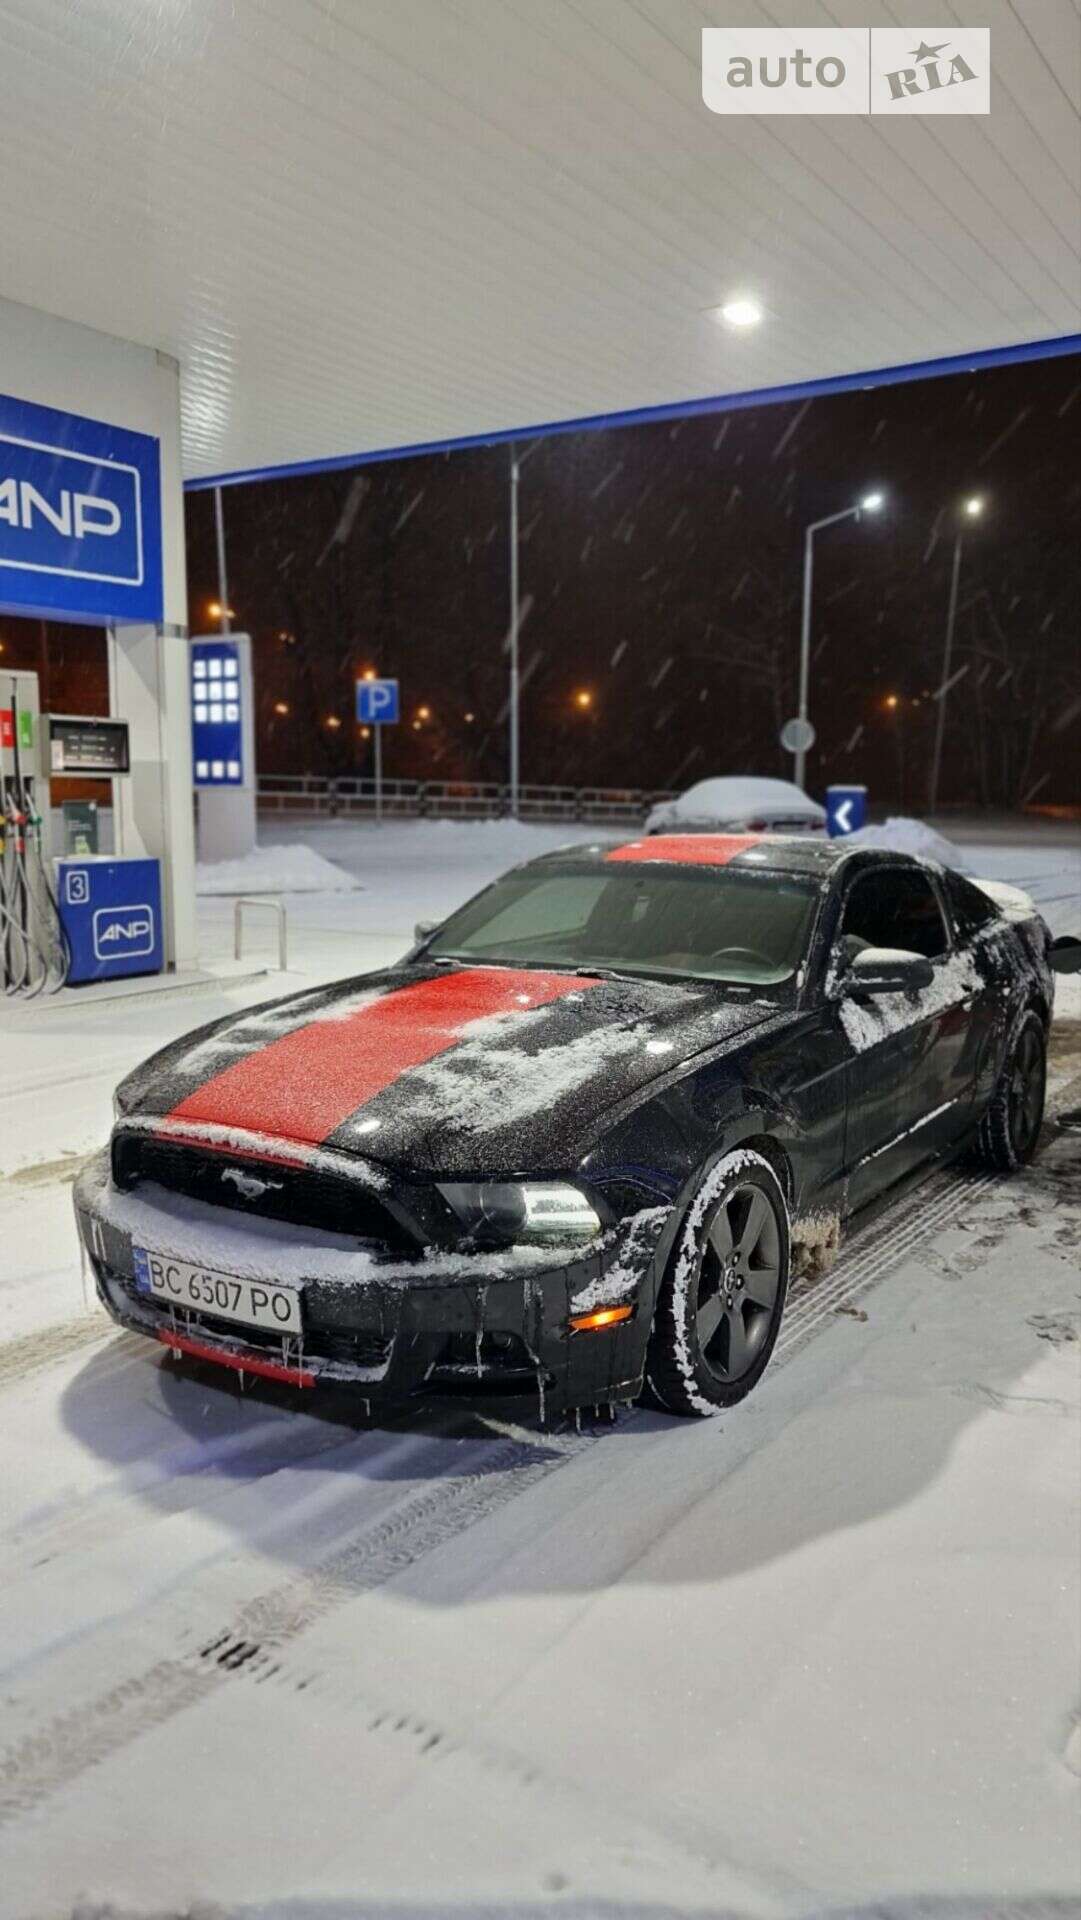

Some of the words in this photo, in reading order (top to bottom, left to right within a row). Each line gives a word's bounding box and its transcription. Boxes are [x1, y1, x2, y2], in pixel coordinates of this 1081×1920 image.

[369, 686, 391, 717] P
[71, 877, 84, 899] 3
[99, 921, 149, 943] ANP
[151, 1260, 181, 1295] BC
[188, 1272, 242, 1312] 6507
[251, 1287, 292, 1322] PO
